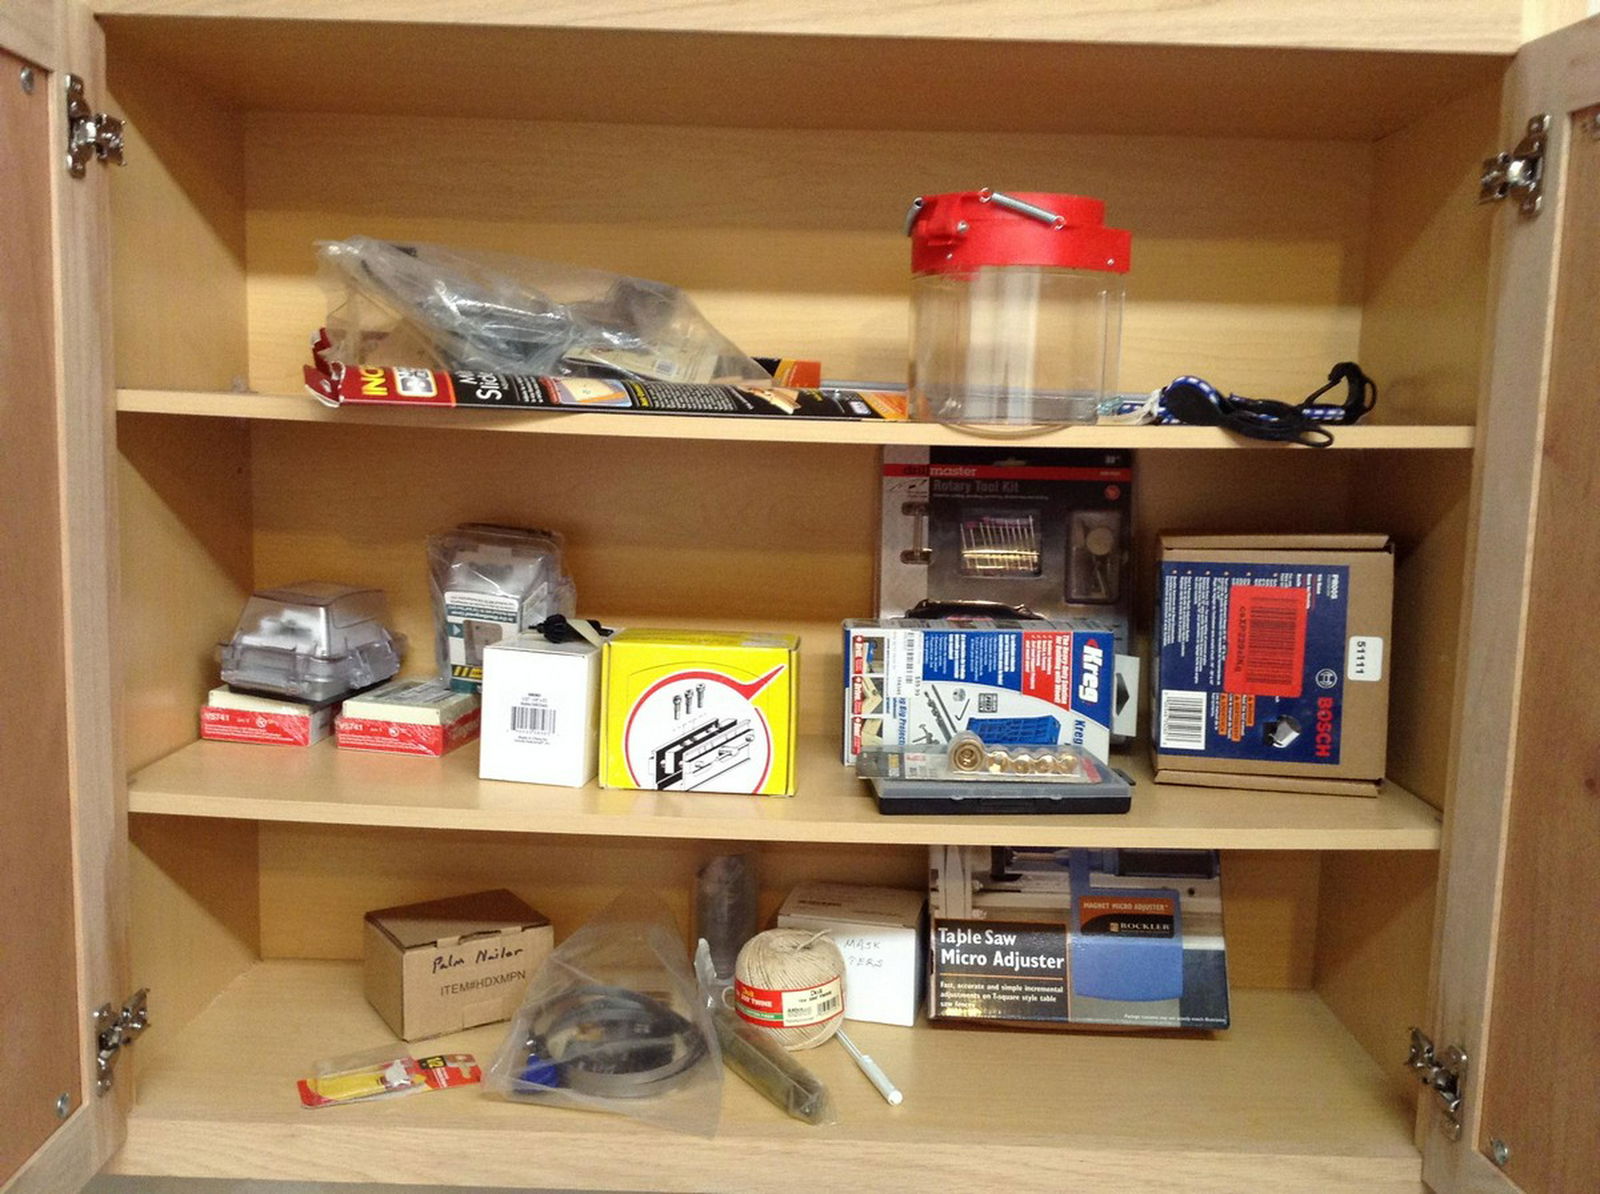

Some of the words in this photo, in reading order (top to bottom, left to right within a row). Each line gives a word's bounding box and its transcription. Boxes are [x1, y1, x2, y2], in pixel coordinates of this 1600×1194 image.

[933, 480, 971, 493] Rotary
[975, 480, 999, 492] Tool
[1002, 481, 1019, 493] Kit
[1356, 641, 1366, 674] 51111
[1079, 645, 1102, 703] Kreg
[1060, 678, 1069, 704] Solution
[1074, 719, 1086, 746] Kreg
[1316, 697, 1333, 757] BOSCH
[1120, 922, 1170, 930] ROCKLER
[845, 939, 881, 951] MASK
[938, 927, 981, 947] Table
[984, 929, 1017, 946] Saw
[432, 954, 465, 974] Palm
[941, 949, 987, 966] Micro
[992, 950, 1065, 972] Adjuster
[441, 970, 526, 997] ITEM#HDXMPN
[940, 981, 956, 989] Fast,
[957, 982, 984, 990] accurate
[987, 983, 999, 991] and
[1001, 984, 1023, 992] simple
[1025, 985, 1064, 993] incremental
[940, 992, 981, 1000] adjustments
[993, 993, 1020, 1001] T-square
[1021, 994, 1038, 1003] style
[1040, 994, 1056, 1003] table
